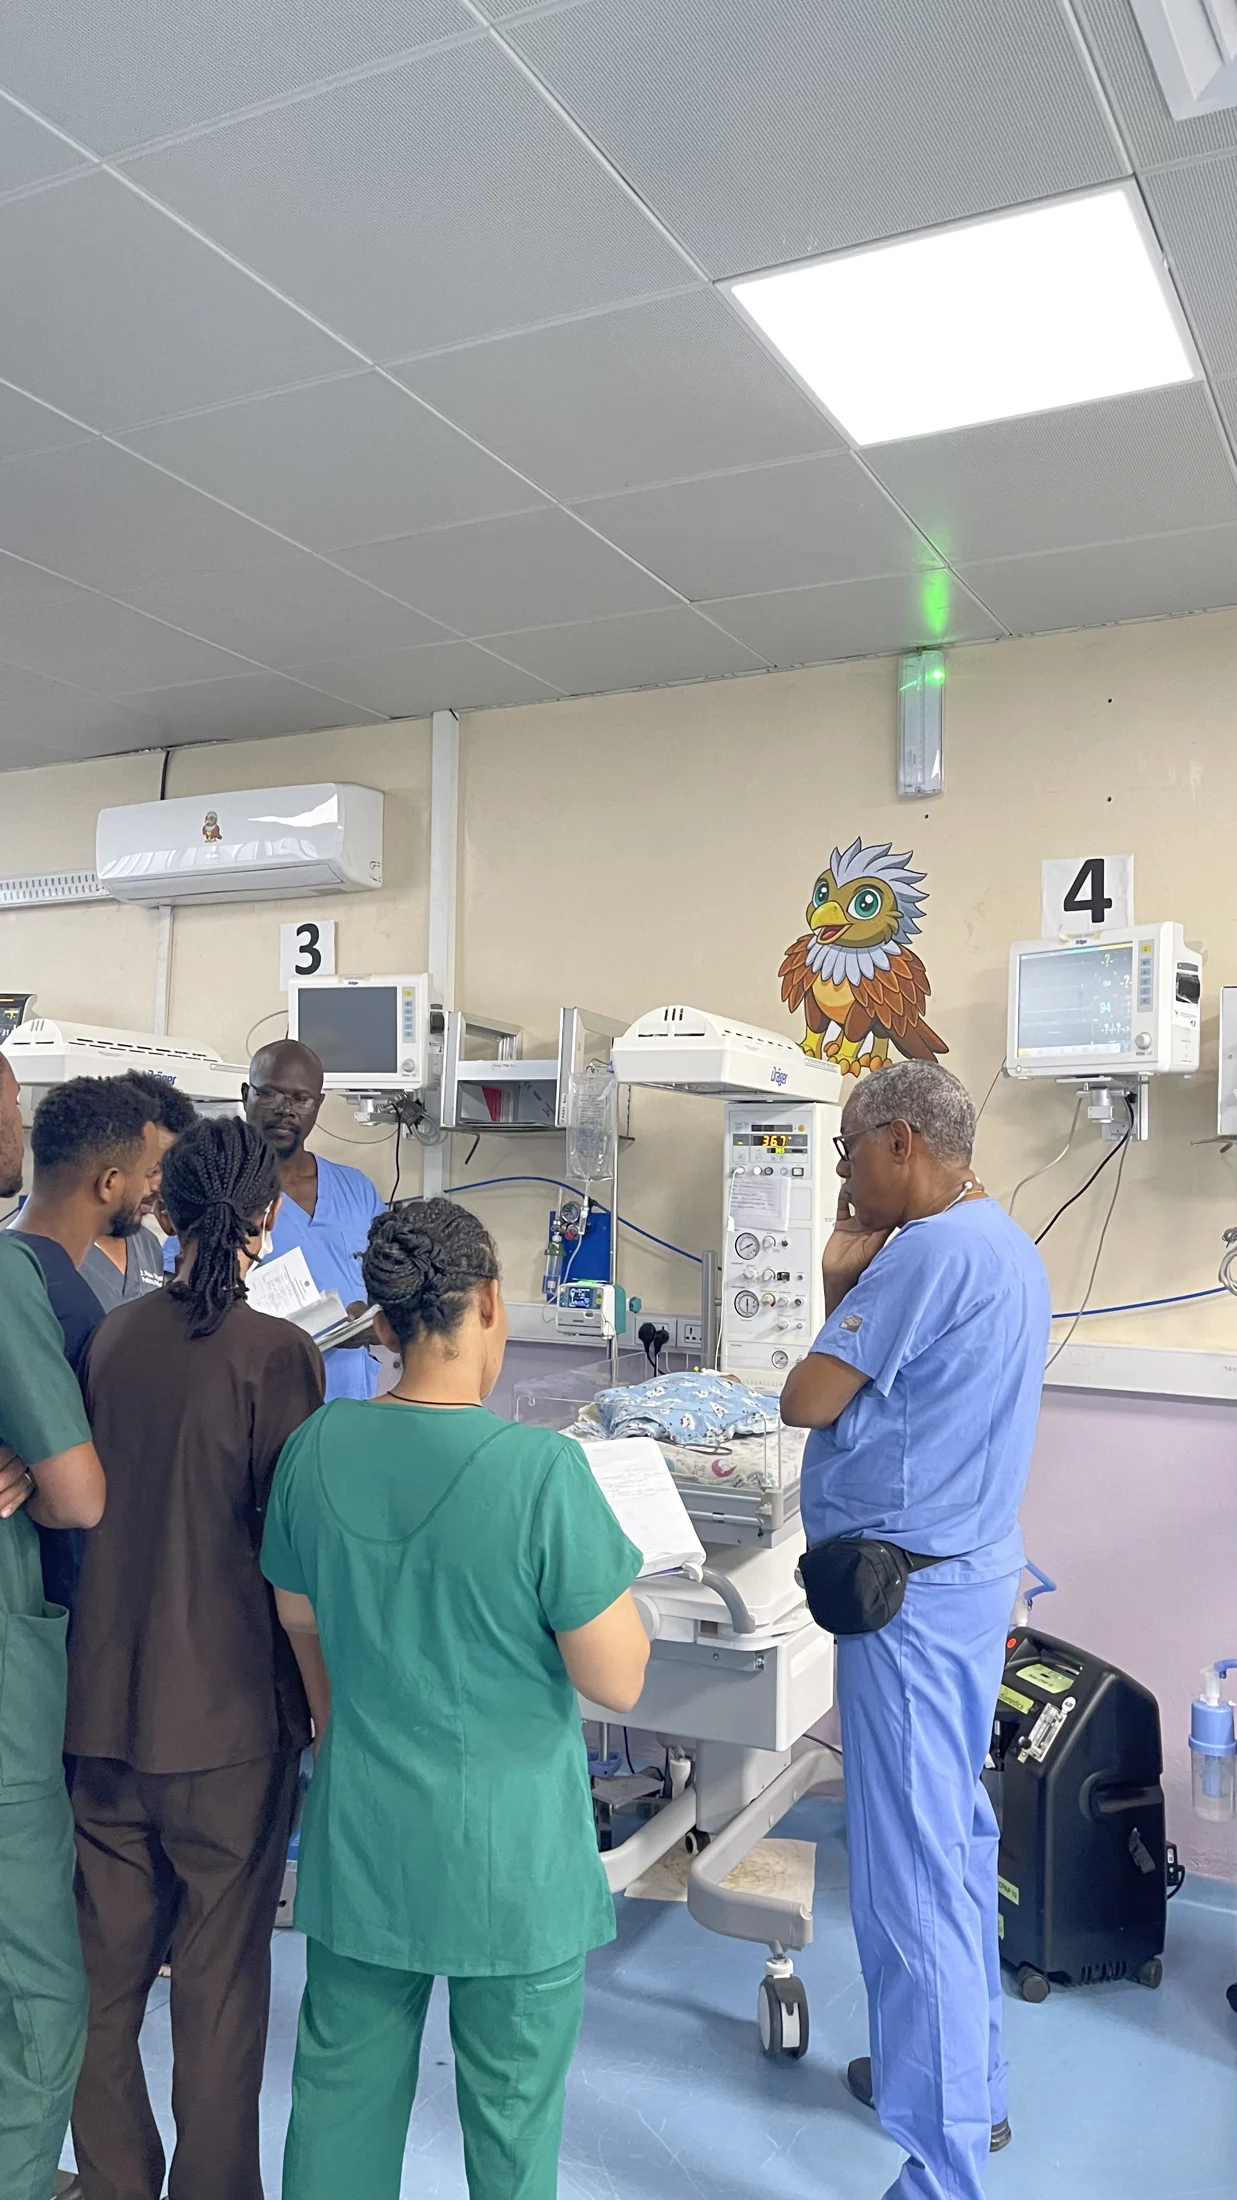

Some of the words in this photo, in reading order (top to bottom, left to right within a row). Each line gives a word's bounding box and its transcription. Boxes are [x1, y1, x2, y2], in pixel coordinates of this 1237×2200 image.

[1063, 858, 1112, 923] 4
[294, 923, 322, 975] 3
[1100, 1001, 1111, 1013] 94
